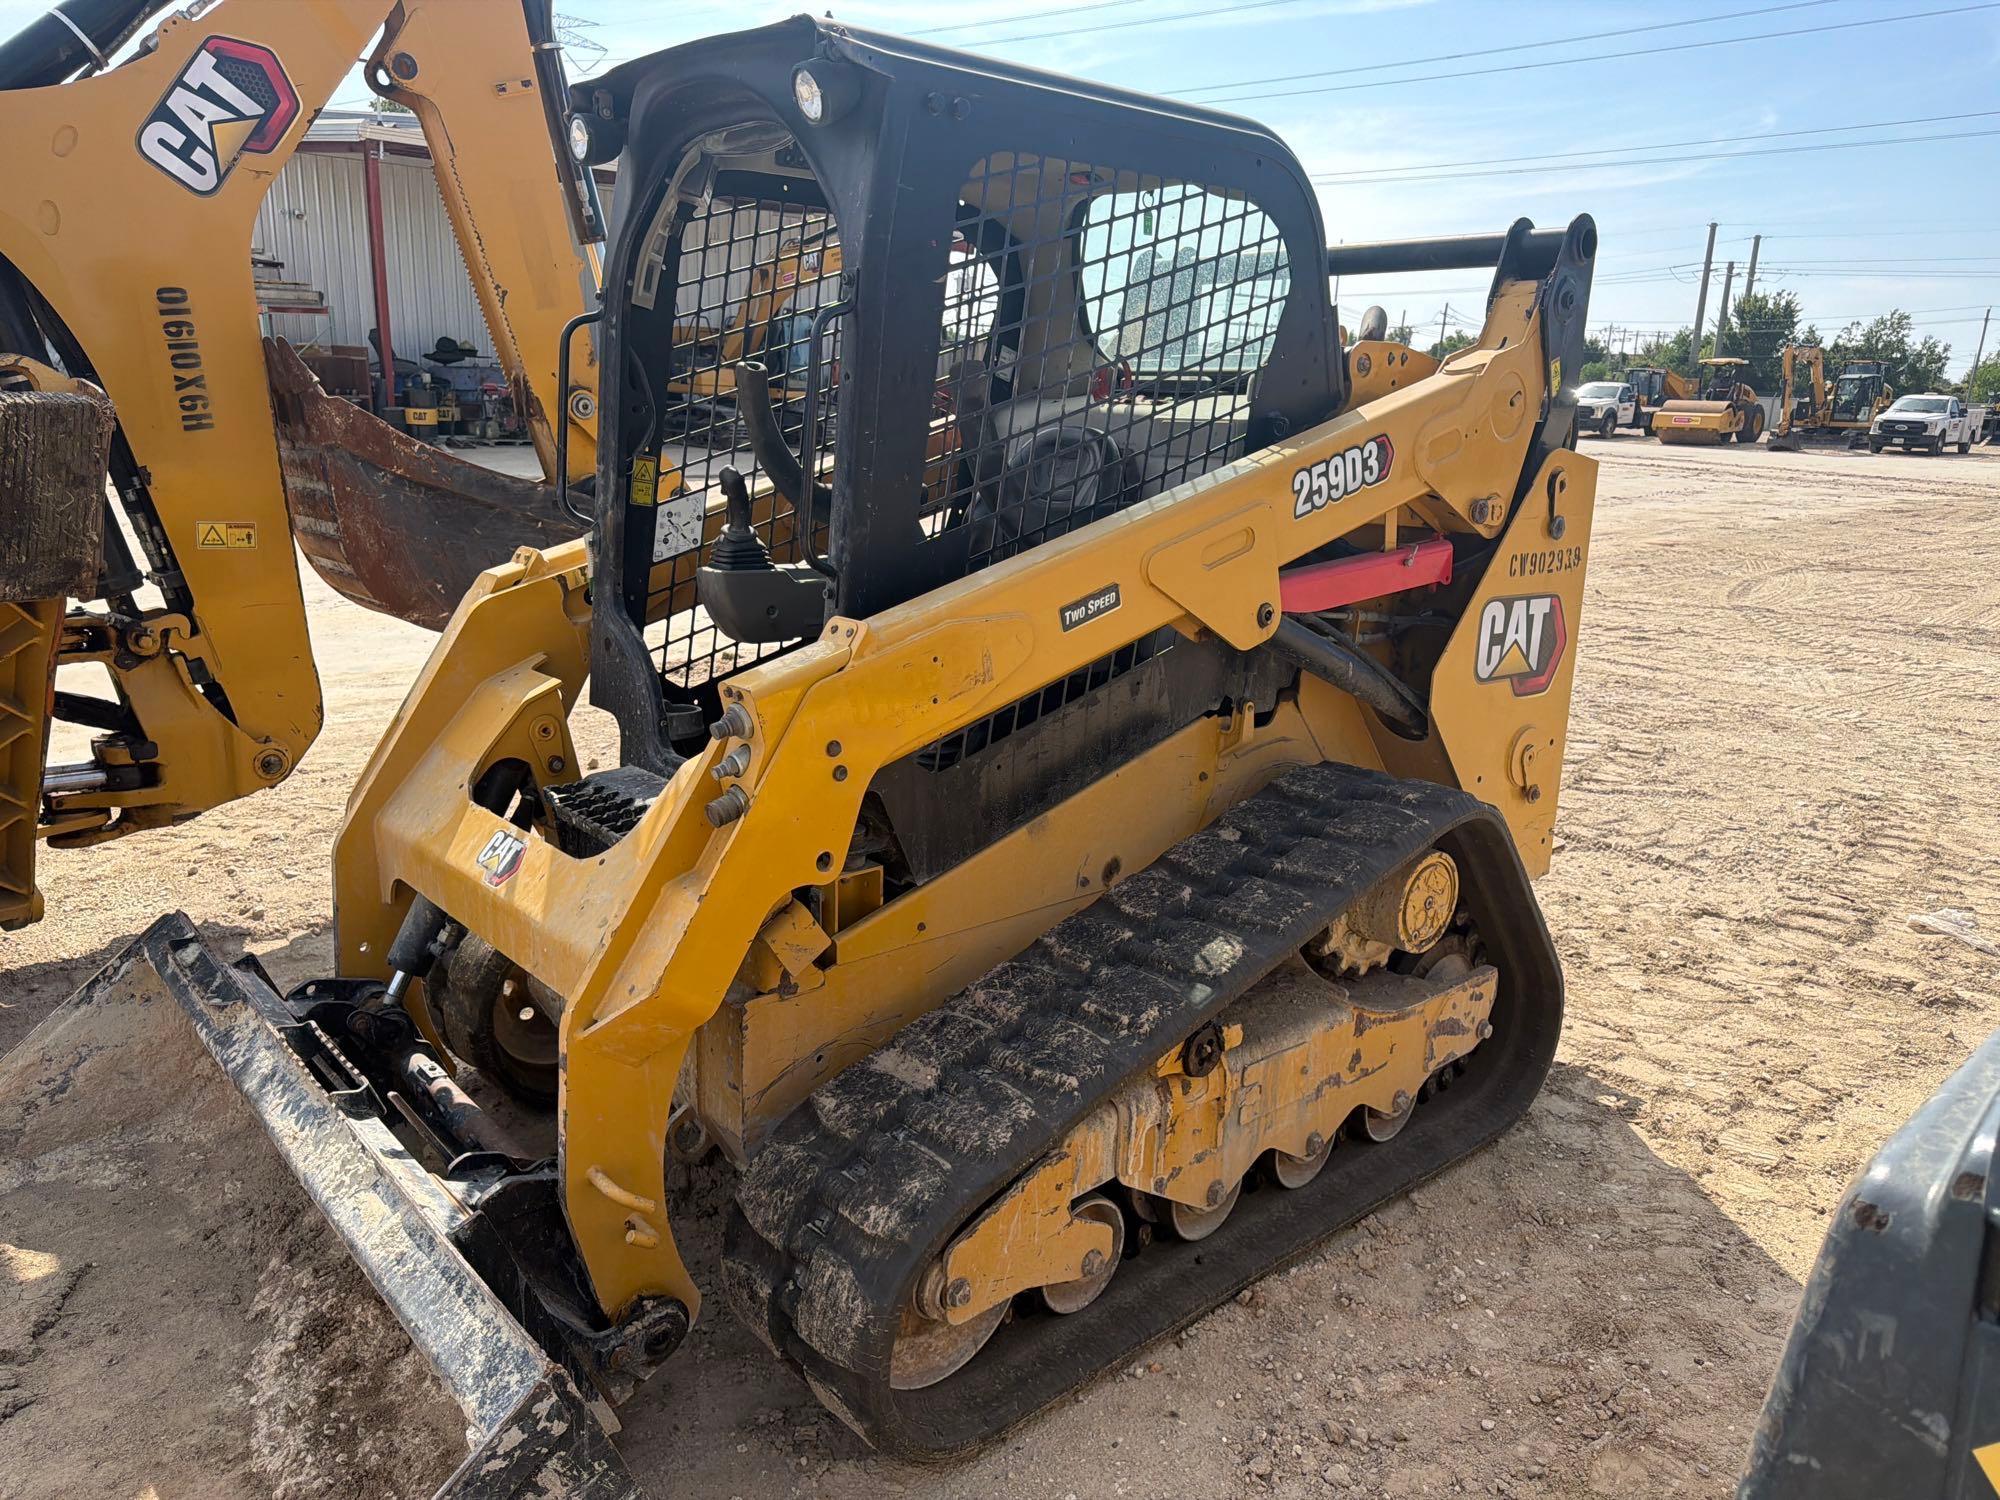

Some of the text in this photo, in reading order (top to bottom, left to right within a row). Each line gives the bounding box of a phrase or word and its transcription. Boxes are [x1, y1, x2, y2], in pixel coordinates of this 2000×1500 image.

[140, 49, 266, 192] CAT
[156, 286, 215, 432] H9X01910
[413, 411, 427, 421] CAT
[1293, 441, 1379, 516] 259D3
[1509, 546, 1582, 577] CW902939
[1477, 598, 1551, 679] CAT
[478, 831, 523, 874] CAT
